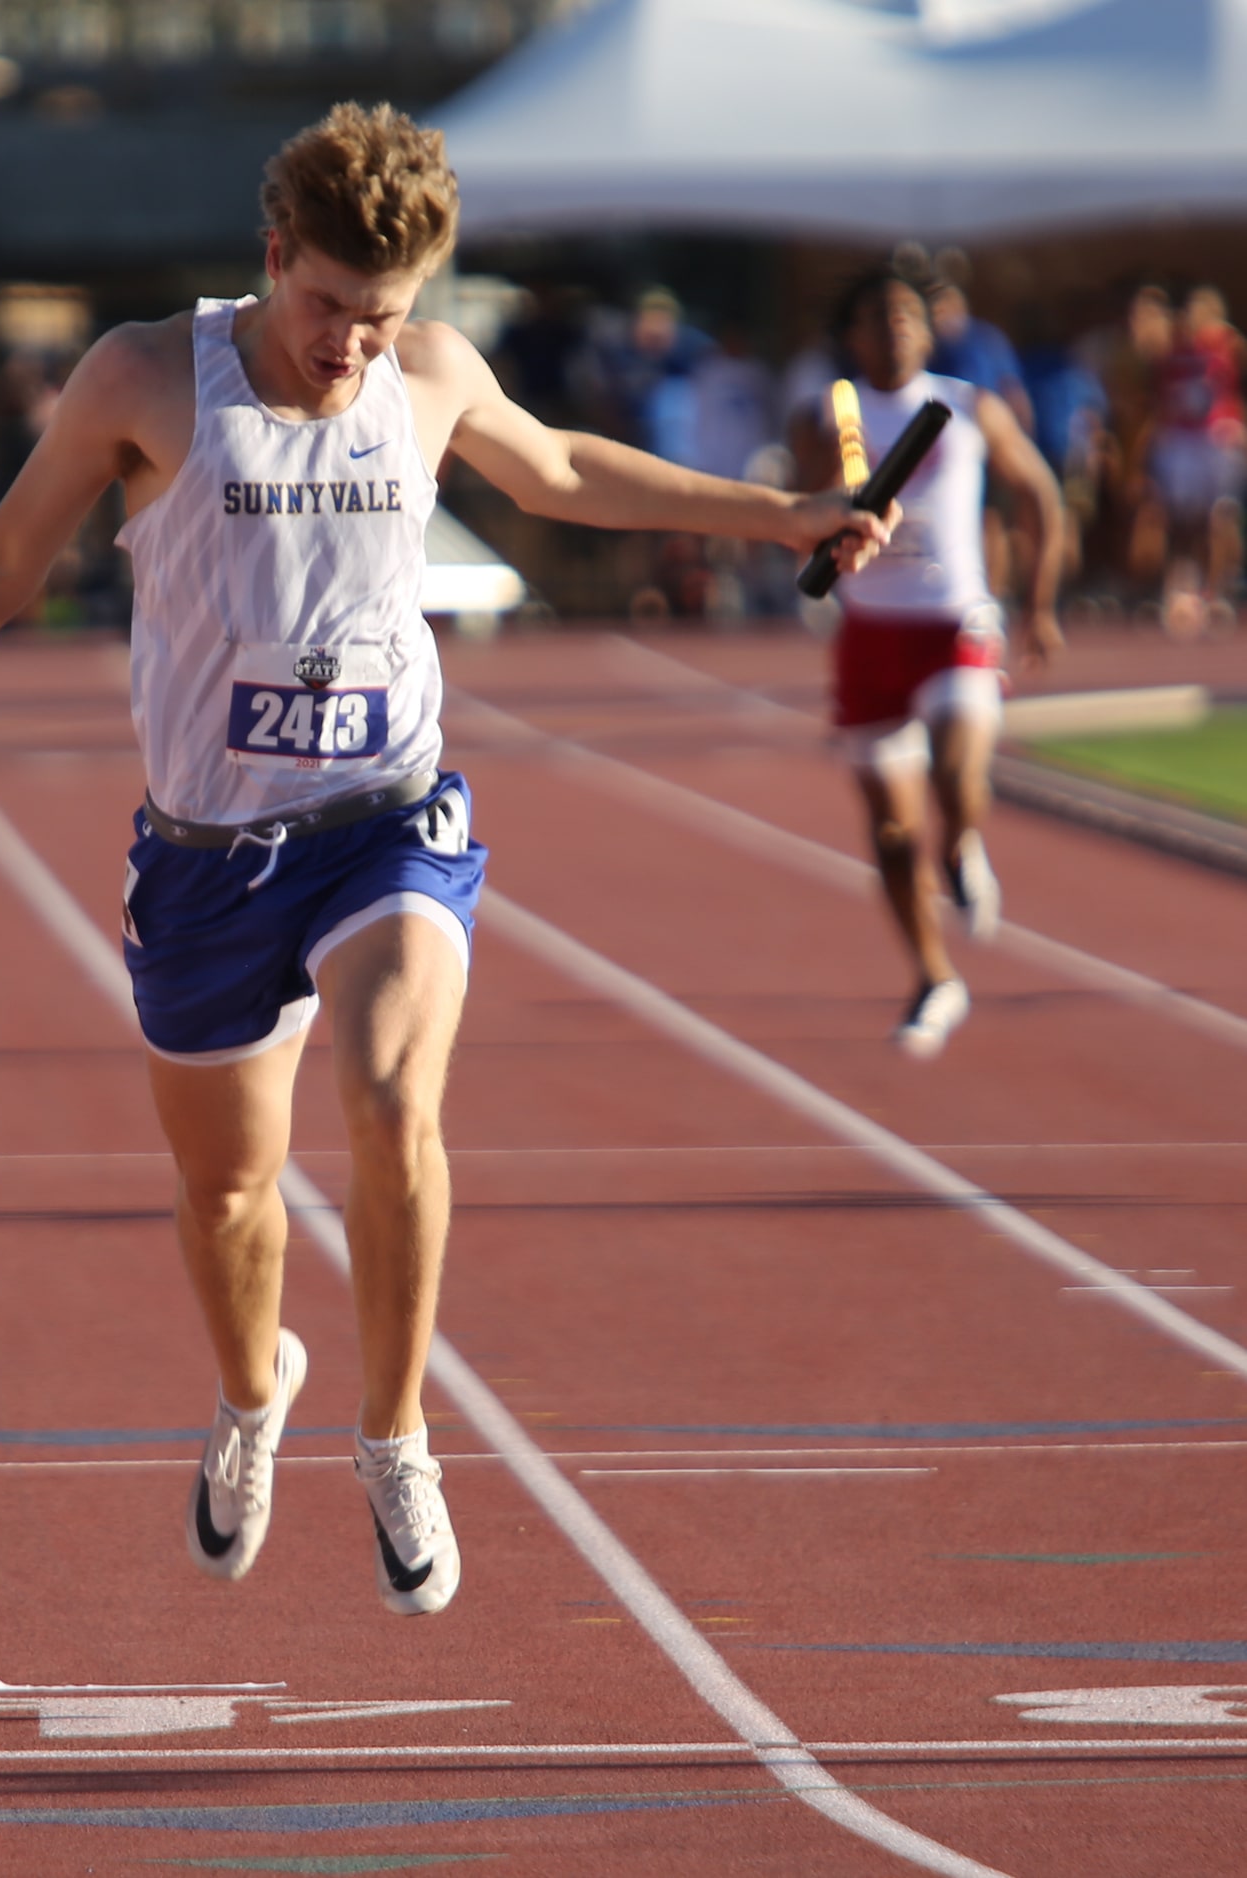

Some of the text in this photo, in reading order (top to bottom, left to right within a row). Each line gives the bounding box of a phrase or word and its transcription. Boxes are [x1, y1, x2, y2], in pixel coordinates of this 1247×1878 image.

[223, 480, 403, 515] SUNNYVALE
[295, 662, 341, 678] STATE
[247, 690, 368, 753] 2413
[295, 758, 320, 769] 2021
